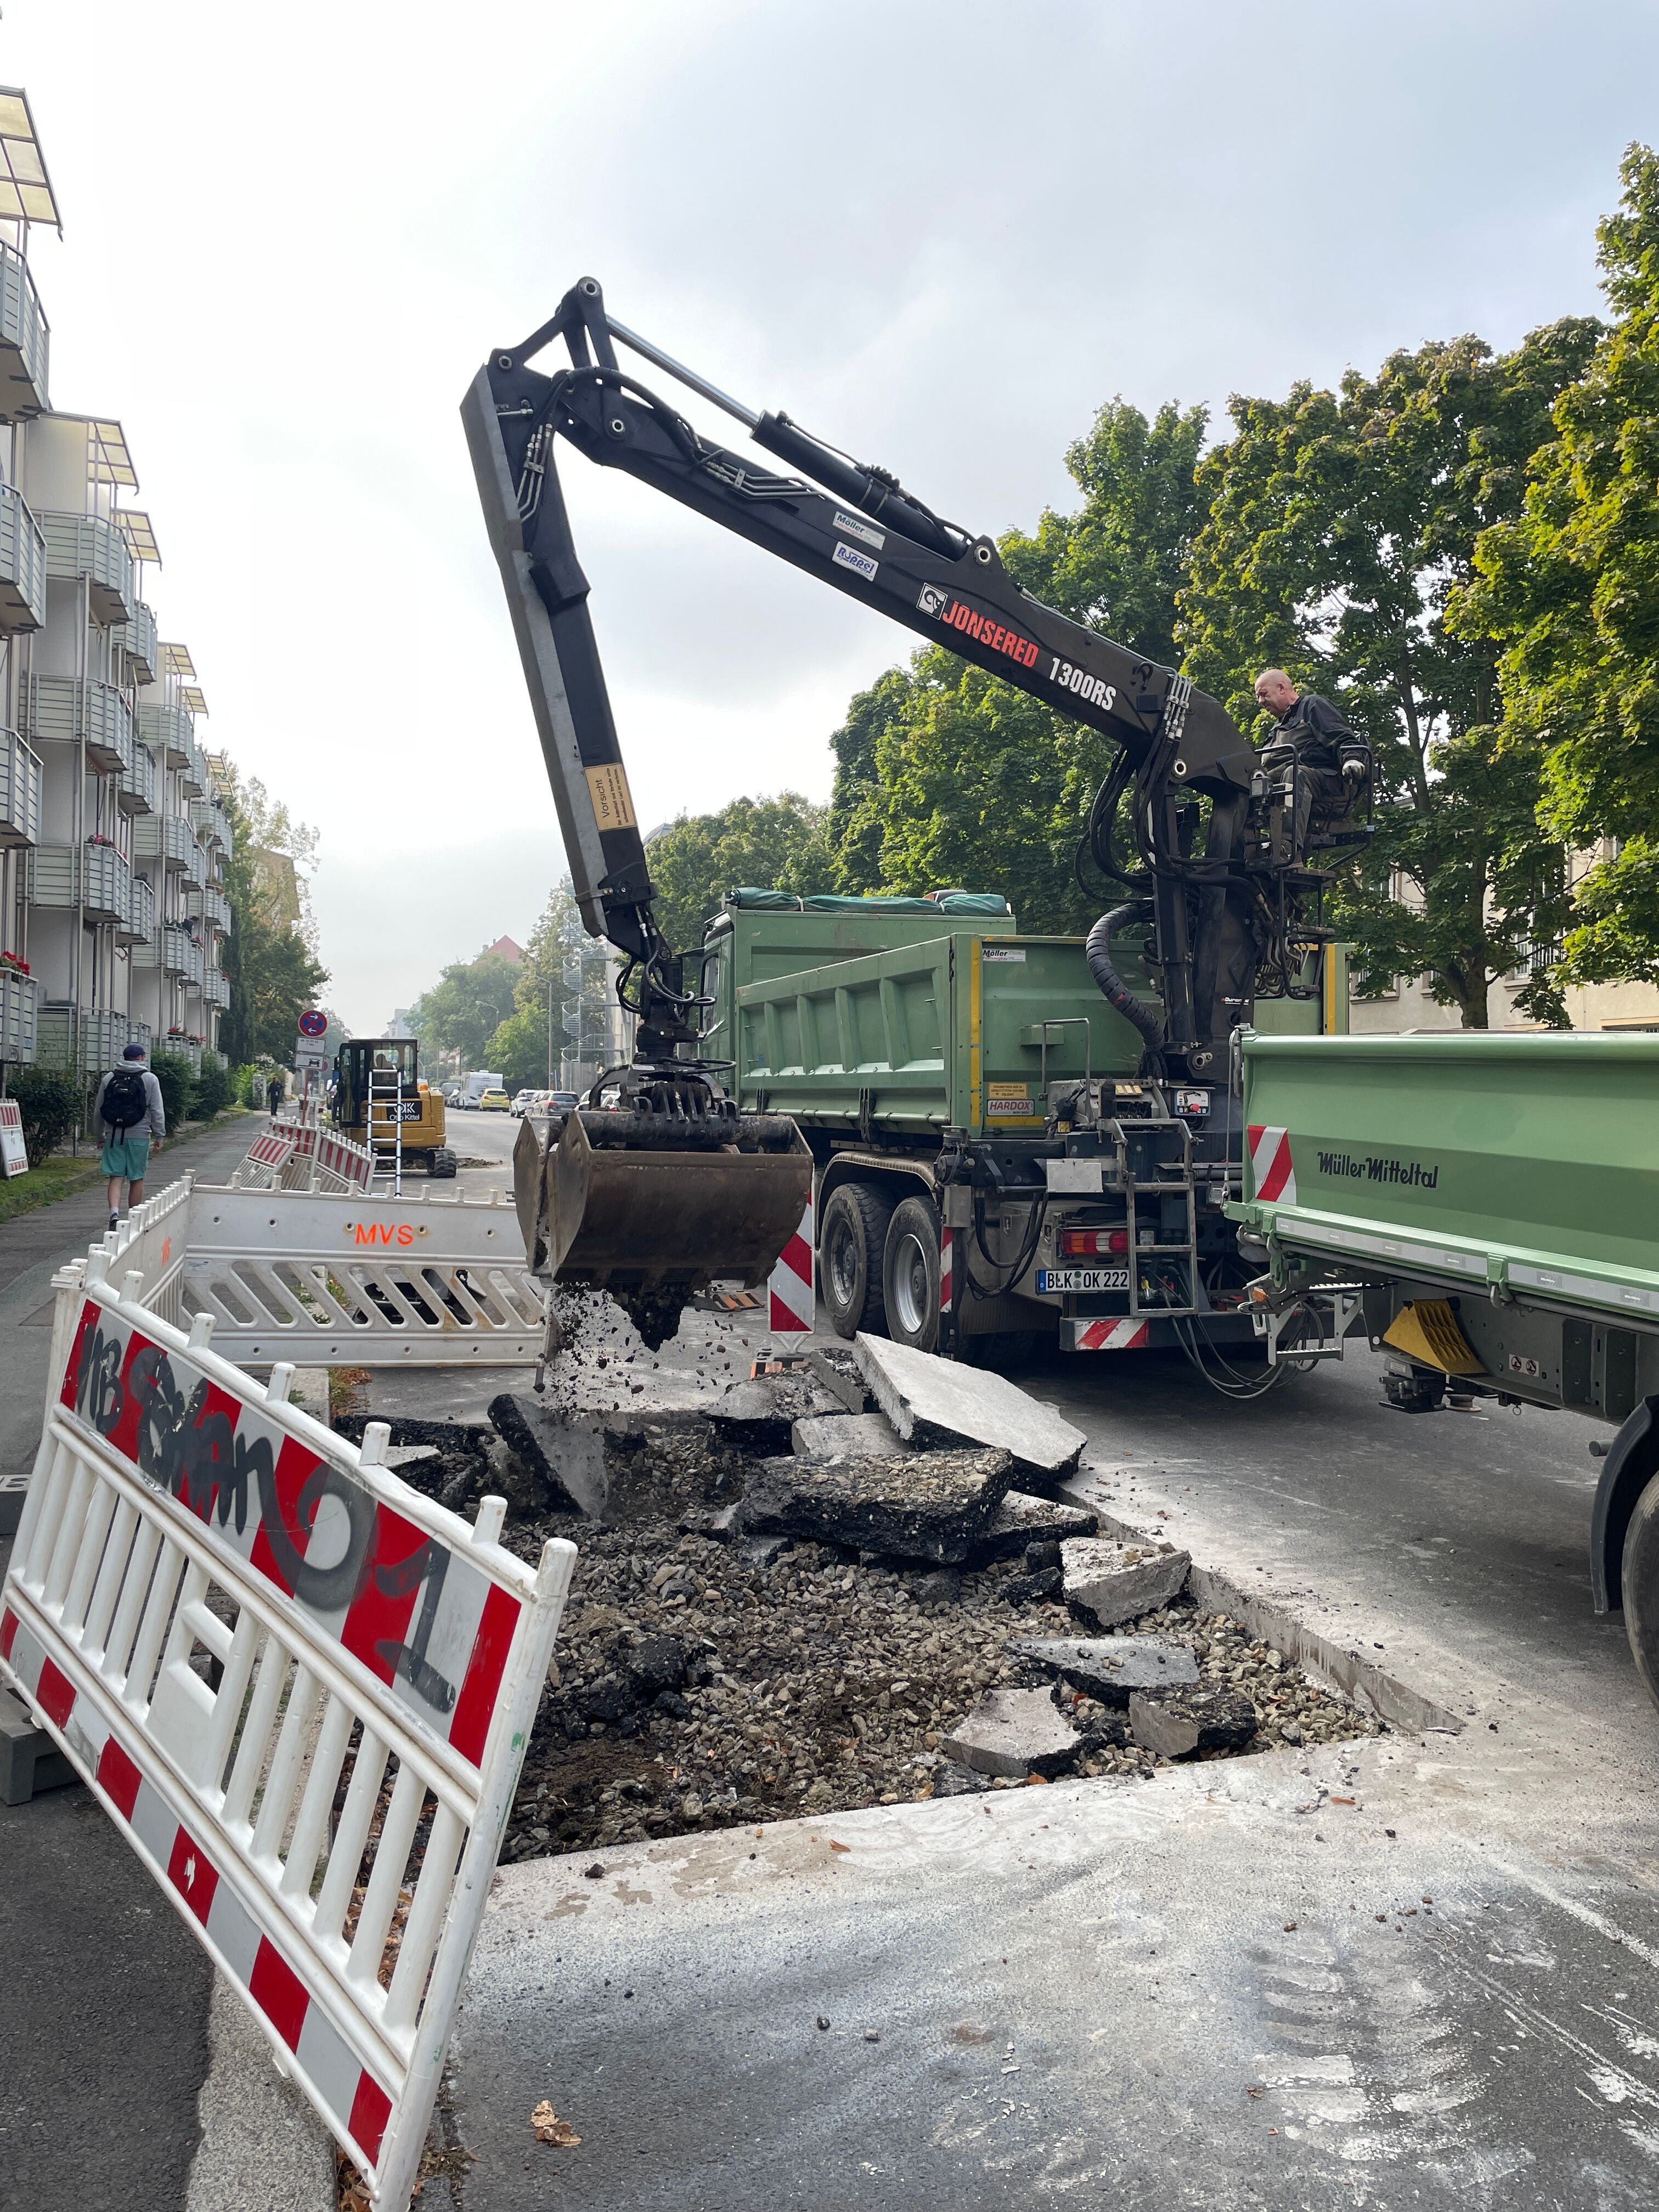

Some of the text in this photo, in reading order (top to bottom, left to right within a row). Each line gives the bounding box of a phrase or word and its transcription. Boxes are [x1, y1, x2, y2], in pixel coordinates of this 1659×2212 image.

[837, 515, 865, 533] Möller
[943, 601, 1116, 710] JONSERED 1300RS
[595, 779, 610, 818] Vorsicht
[990, 1102, 1030, 1110] HARDOX
[355, 1223, 414, 1245] MVS
[1047, 1271, 1128, 1289] BLK OK 222
